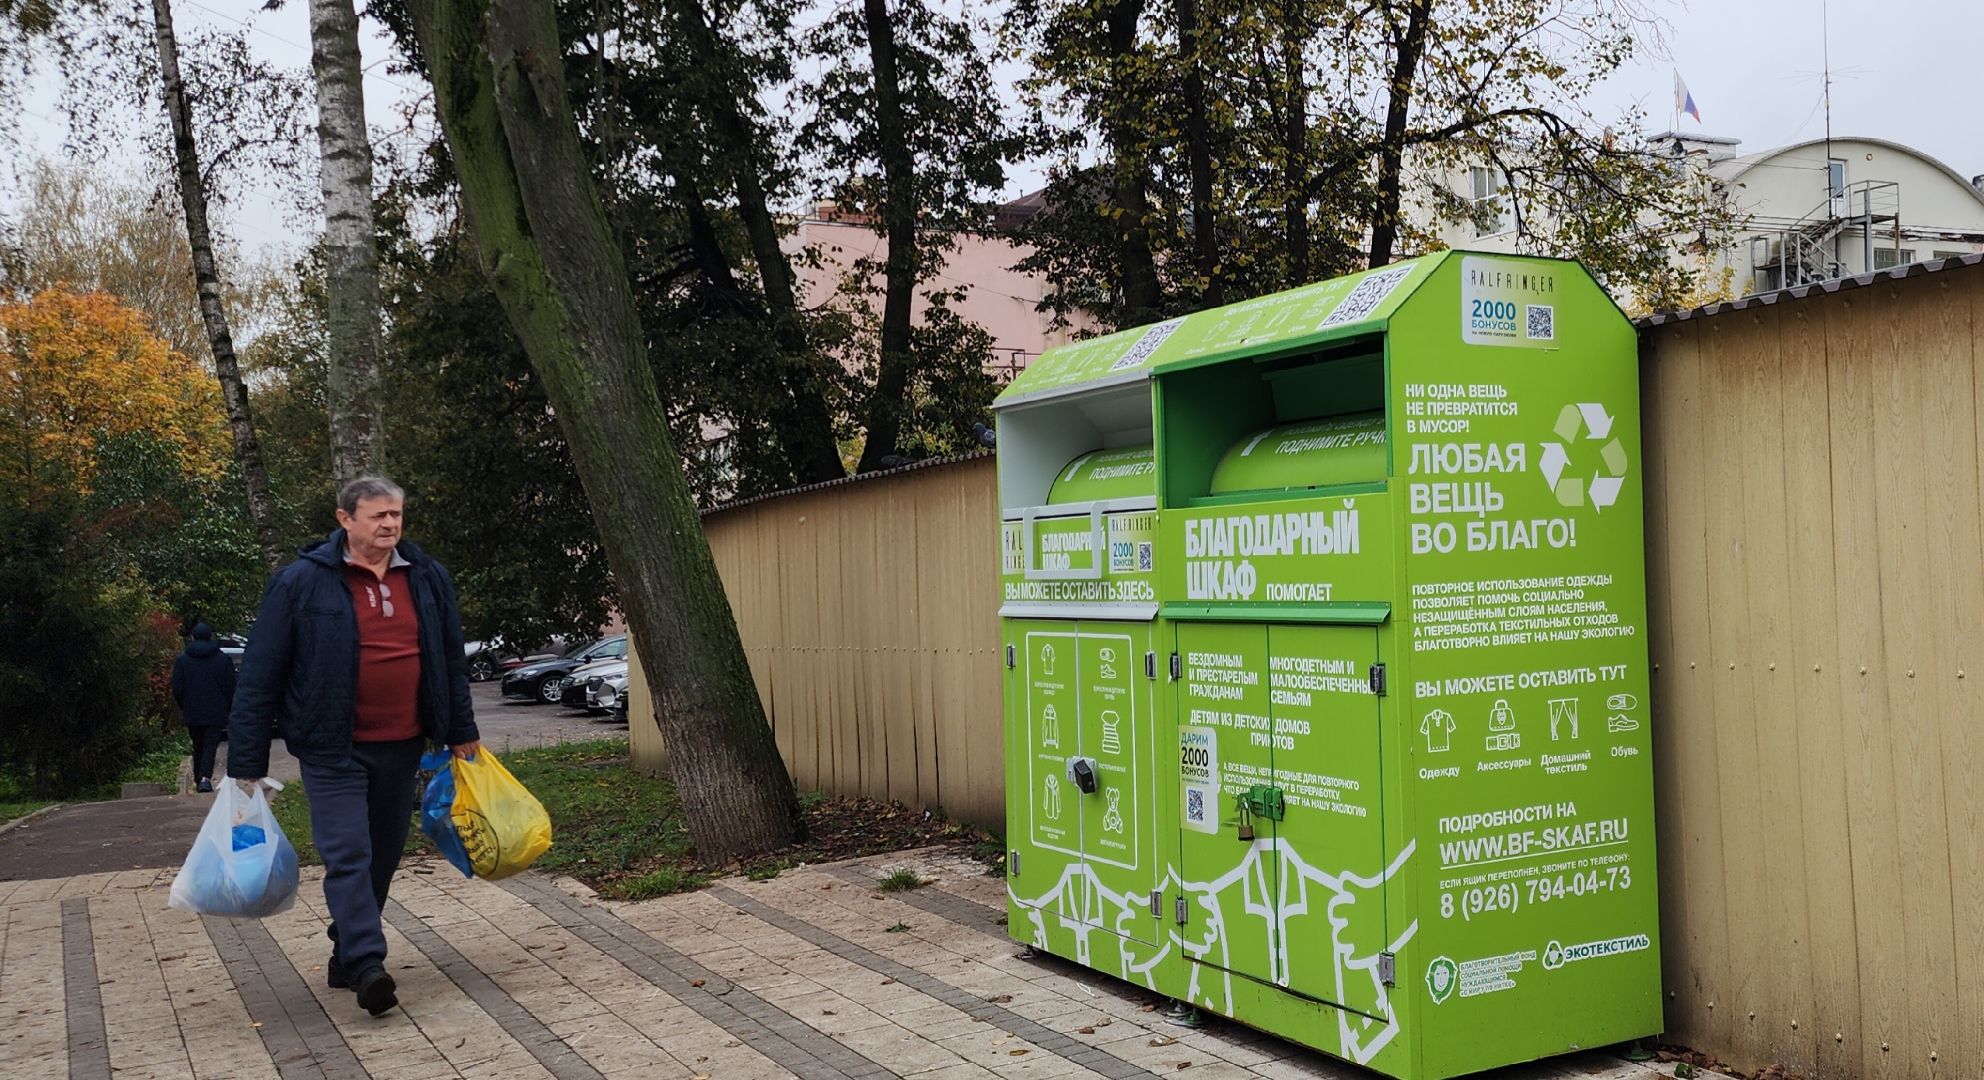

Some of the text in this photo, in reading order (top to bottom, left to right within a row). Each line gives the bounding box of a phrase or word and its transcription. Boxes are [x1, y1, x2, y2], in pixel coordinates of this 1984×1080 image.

[1472, 300, 1516, 320] 2000
[1472, 320, 1517, 331] БОНУСОВ
[1406, 384, 1507, 400] НИ ОДНА ВЕЩЬ
[1406, 402, 1518, 416] НЕ ПРЕВРАТИТСЯ
[1407, 420, 1469, 433] В МУСОР!
[1275, 432, 1355, 454] ПОДНИМИТЕ
[1408, 443, 1526, 474] ЛЮБАЯ
[1410, 482, 1504, 518] ВЕЩЬ
[1186, 498, 1360, 558] БЛАГОДАРНЫЙ
[1412, 518, 1576, 554] ВО БЛАГО!
[1006, 530, 1023, 550] RAL
[1042, 526, 1106, 552] БЛАГОДАРНЙ
[1114, 542, 1133, 557] 2000
[1006, 556, 1024, 569] RING
[1114, 558, 1133, 567] БОНУСОВ
[1186, 560, 1332, 601] ШКАФ ПОМОГАЕТ
[1412, 574, 1612, 595] ПОВТОРНОЕ ИСПОЛЬЗОВАНИЕ ОДЕЖДЫ
[1006, 580, 1154, 602] ВЫ МОЖЕТЕ ОСТАВИТЬ ЗДЕСЬ
[1413, 590, 1584, 609] ПОЗВОЛЯЕТ ПОМОЧЬ СОЦИАЛЬНО
[1413, 601, 1608, 624] НЕЗАЩИЩЁННЫМ СЛОЯМ НАСЕЛЕНИЯ,
[1414, 614, 1618, 637] А ПЕРЕРАБОТКА ТЕКСТИЛЬНЫХ ОТХОДОВ
[1415, 625, 1634, 651] БЛАГОТВОРНО ВЛИЯЕТ НА НАШУ ЭКОЛОГИЮ
[1188, 652, 1243, 668] БЕЗДОМНЫМ
[1270, 656, 1354, 674] МНОГОДЕТНЫМ И
[1188, 669, 1258, 685] И ПРЕСТАРЕЛЫМ
[1270, 674, 1376, 694] МАЛООБЕСПЕЧЕННЫ
[1415, 664, 1627, 698] ВЫ МОЖЕТЕ ОСТАВИТЬ ТУТ
[1189, 684, 1243, 700] ГРАЖДАНАМ
[1271, 691, 1311, 706] СЕМЬЯМ
[1190, 710, 1310, 735] ДЕТЯМ ИЗ ДЕТСКИХ ДОМОВ
[1181, 732, 1208, 746] ДАРИМ
[1181, 747, 1209, 767] 2000
[1541, 750, 1591, 766] Домашний
[1611, 746, 1639, 757] Обувь
[1182, 766, 1209, 778] БОНУСОВ
[1419, 765, 1460, 780] Одежду
[1477, 757, 1531, 772] Аксессуары
[1545, 763, 1588, 775] текстиль
[1224, 762, 1227, 771] А
[1228, 762, 1239, 772] ВСЕ
[1303, 772, 1317, 784] ДЛЯ
[1318, 775, 1359, 791] ПОВТОРНОГО
[1224, 785, 1235, 794] ЧТО
[1296, 784, 1341, 801] ПЕРЕРАБОТКУ,
[1302, 798, 1310, 807] НА
[1312, 799, 1330, 811] НАШУ
[1332, 802, 1366, 817] ЭКОЛОГИЮ
[1440, 802, 1576, 833] ПОДРОБНОСТИ НА
[1440, 818, 1628, 865] WWW.BF-SKAF.RU
[1440, 853, 1630, 890] ЕСЛИ ЯЩИК ПЕРЕПОЛНЕН, ЗВОНИТЕ ПО ТЕЛЕФОНУ:
[1440, 865, 1631, 921] 8 (926) 794-04-73
[1565, 934, 1648, 959] ЭКОТЕКСТИЛЬ
